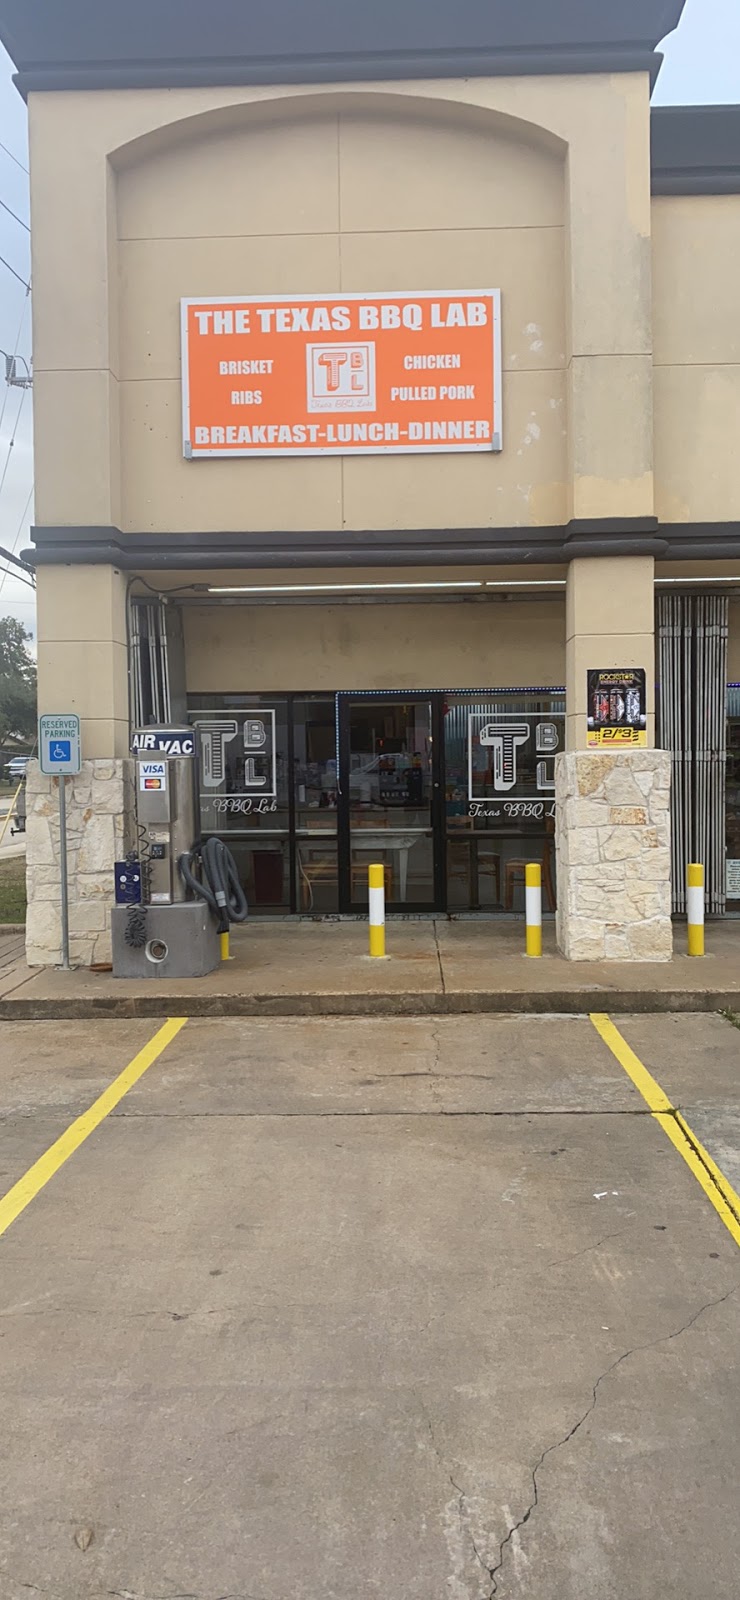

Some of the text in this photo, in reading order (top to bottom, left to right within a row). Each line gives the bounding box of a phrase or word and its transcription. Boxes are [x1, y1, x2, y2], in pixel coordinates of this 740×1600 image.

[194, 301, 488, 335] THE TEXAS BBQ LAB
[219, 360, 274, 375] BRISKET
[350, 352, 363, 368] B
[404, 354, 461, 370] CHICKEN
[318, 352, 347, 391] T
[351, 374, 364, 390] L
[231, 391, 263, 405] RIBS
[391, 385, 475, 401] PULLED PORK
[41, 720, 77, 729] RESERVED
[44, 729, 76, 738] PARKING
[243, 720, 266, 748] B
[536, 723, 559, 751] B
[132, 734, 193, 754] AIR VAC
[193, 720, 238, 787] T
[480, 723, 530, 790] T
[142, 765, 164, 773] VISA
[245, 757, 267, 786] L
[213, 798, 253, 815] BBQ
[253, 798, 277, 814] Lab
[468, 803, 501, 817] Texas
[504, 802, 544, 819] BBQ
